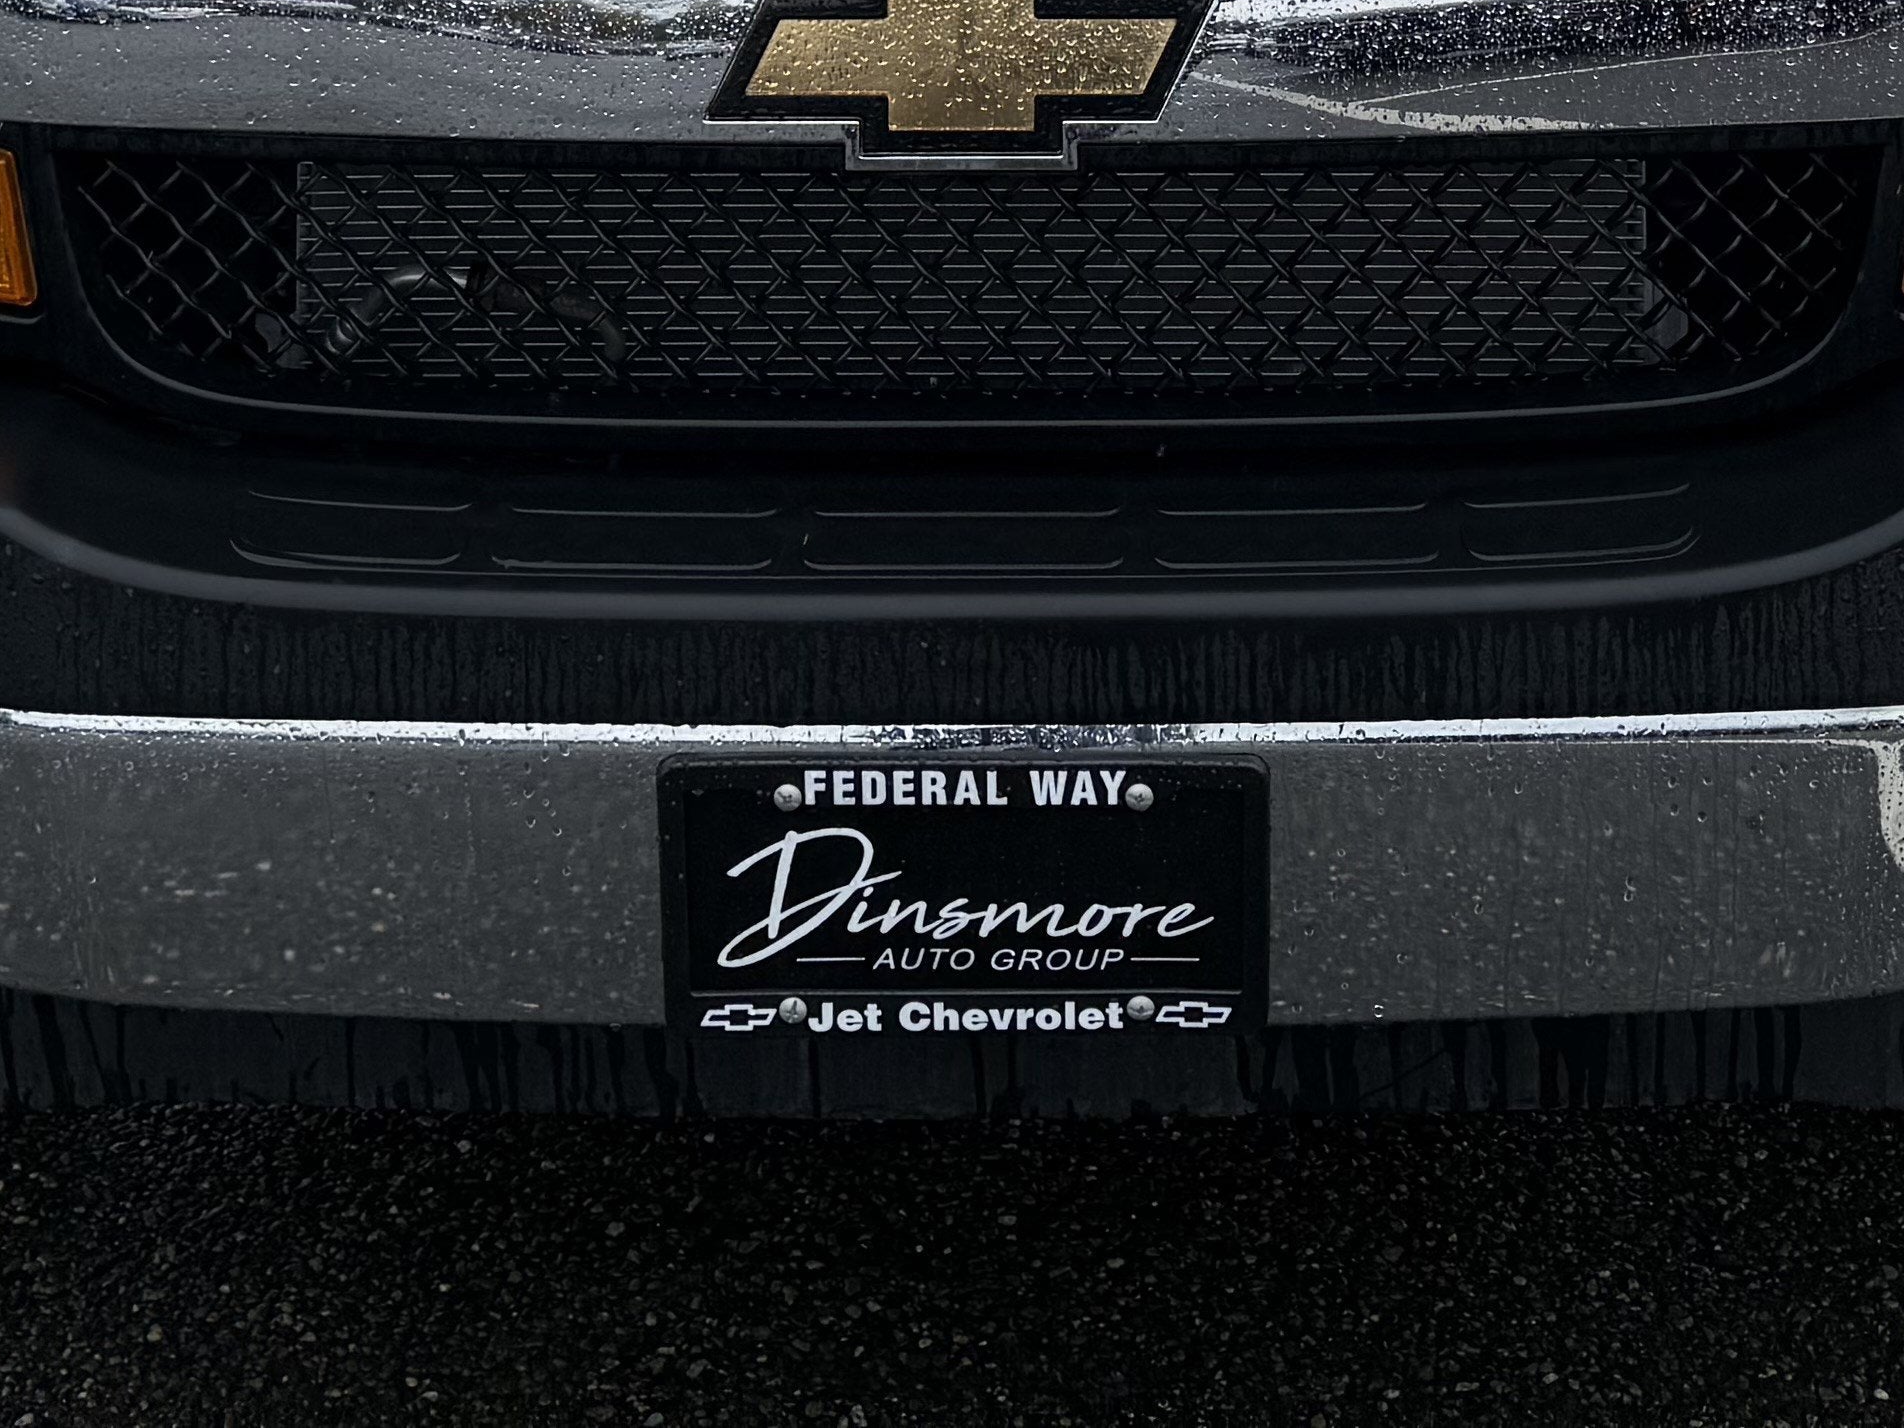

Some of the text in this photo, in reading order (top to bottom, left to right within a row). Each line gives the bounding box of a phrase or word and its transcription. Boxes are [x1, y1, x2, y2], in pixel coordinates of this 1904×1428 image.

[804, 770, 1127, 806] FEDERAL WAY
[716, 827, 1215, 969] Dinsmore
[872, 947, 1124, 972] AUTO GROUP
[808, 1001, 1124, 1033] Jet Chevrolet
